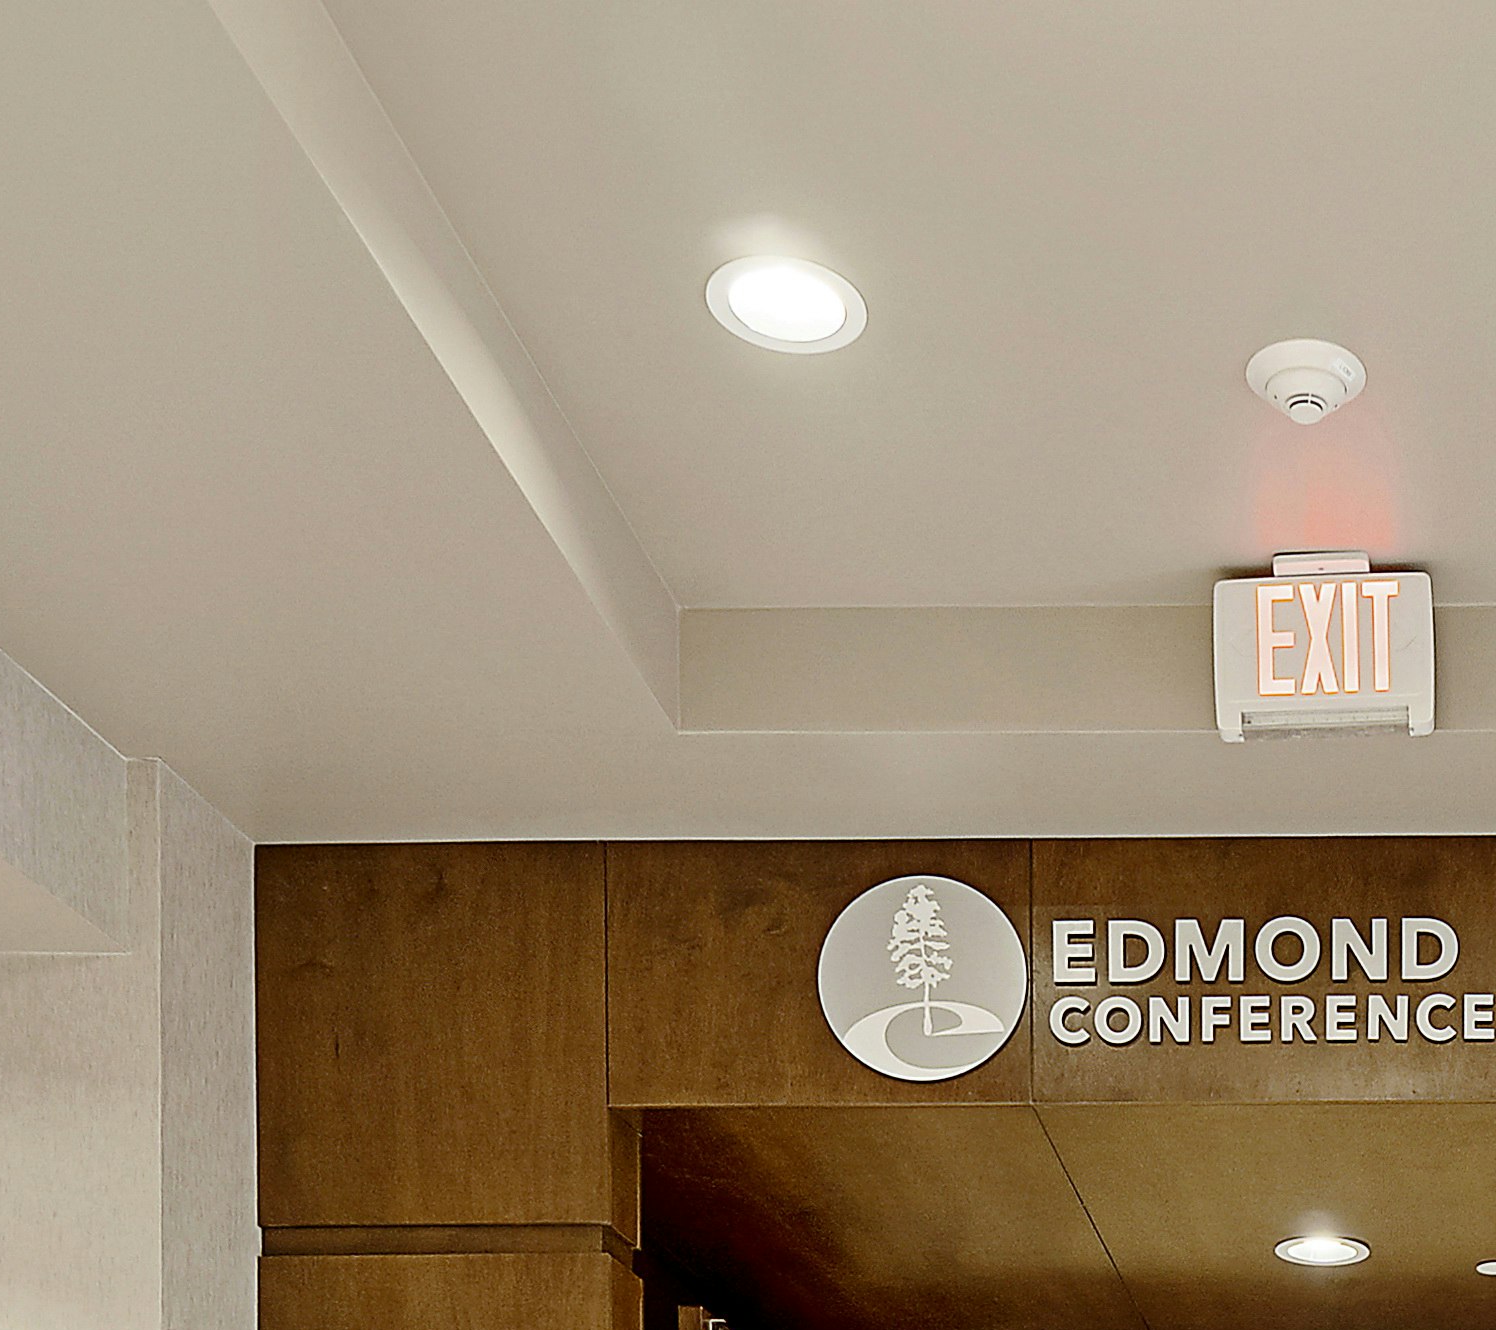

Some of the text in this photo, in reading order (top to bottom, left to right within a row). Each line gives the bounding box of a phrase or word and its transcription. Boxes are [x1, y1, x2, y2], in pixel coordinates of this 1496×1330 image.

[1255, 579, 1400, 697] EXIT
[1051, 916, 1459, 984] EDMOND
[1049, 993, 1496, 1044] CONFERENCE
